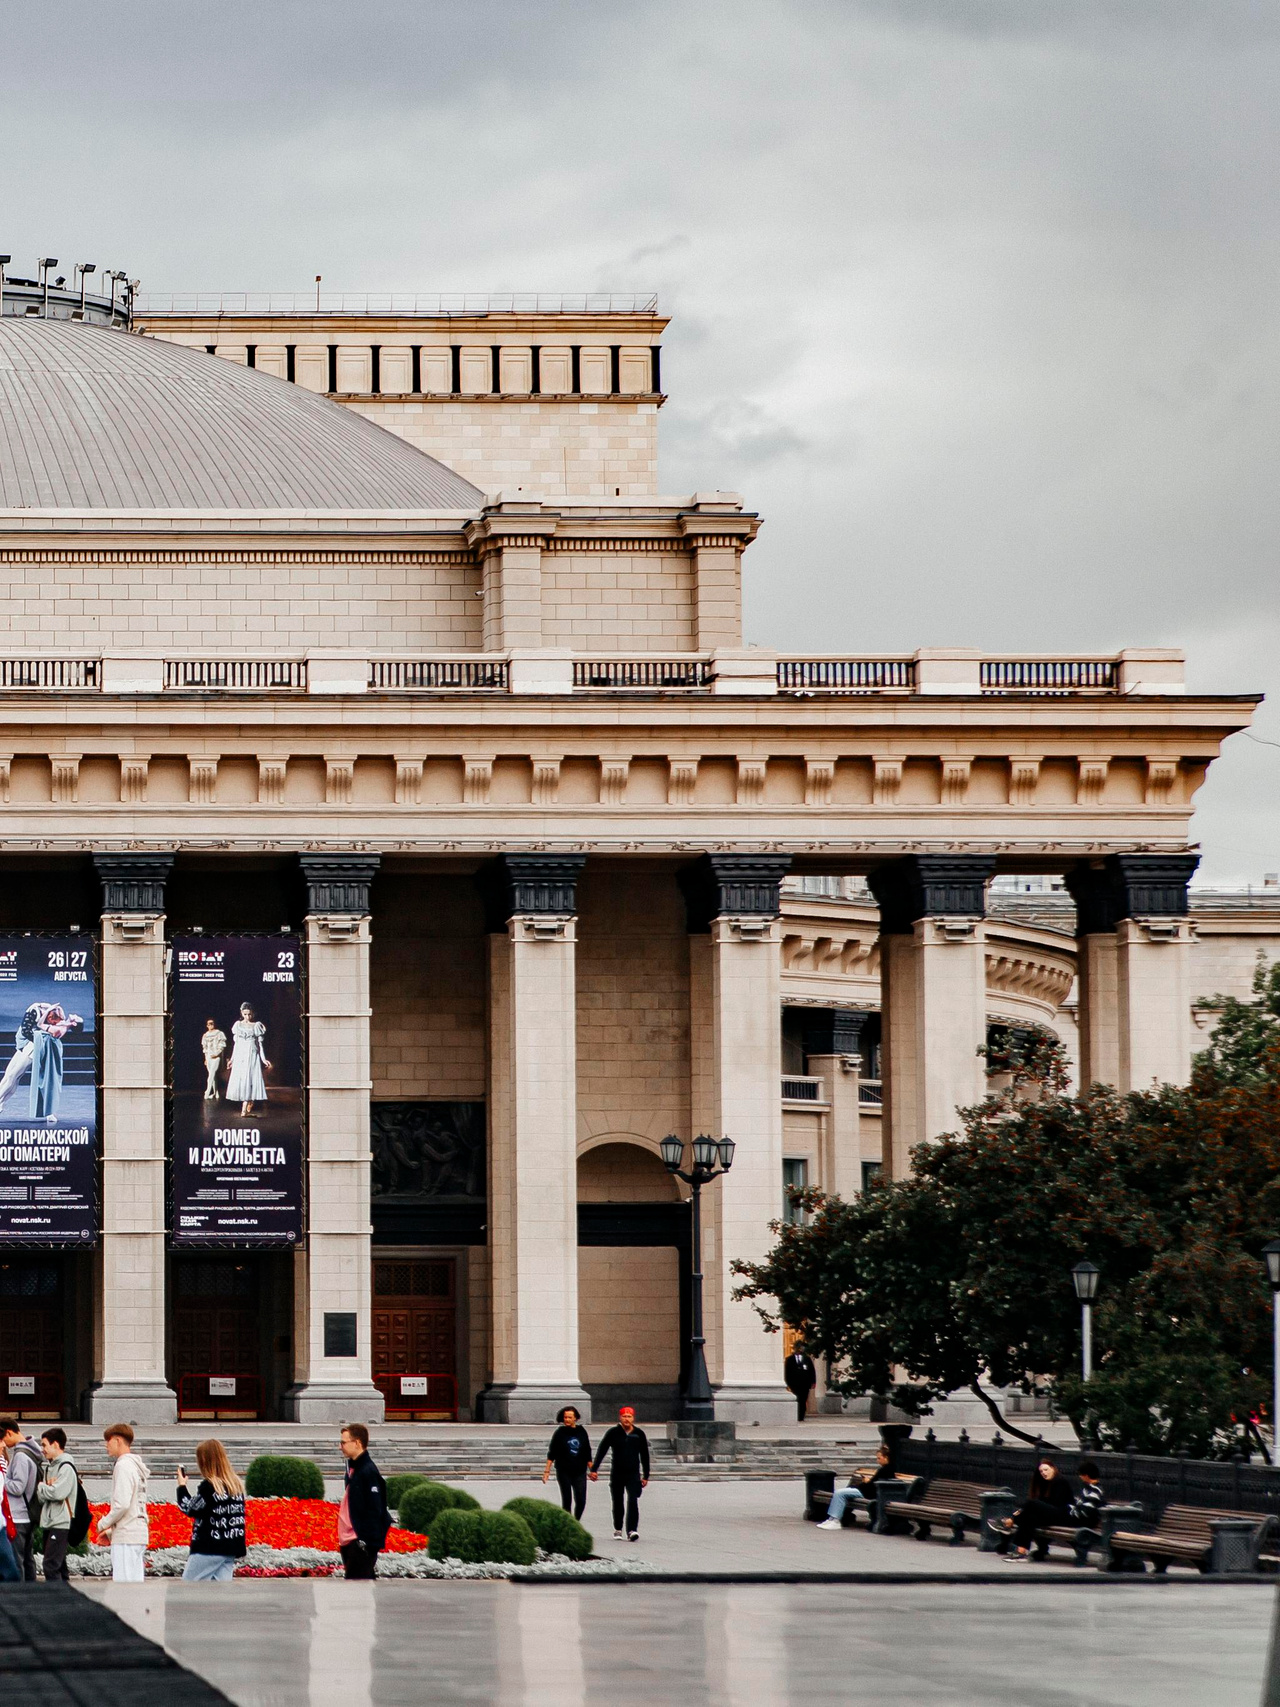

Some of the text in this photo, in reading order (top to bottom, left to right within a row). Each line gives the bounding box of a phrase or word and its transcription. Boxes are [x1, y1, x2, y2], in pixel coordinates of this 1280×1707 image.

[278, 952, 294, 968] 23
[54, 971, 87, 981] АВГУСТА
[263, 972, 294, 982] АВГУСТА
[14, 1127, 89, 1145] ПАРИЖСКОЙ
[214, 1129, 260, 1146] РОМЕО
[189, 1148, 286, 1166] И ДЖУЛЬЕТТА
[211, 1530, 220, 1540] IS
